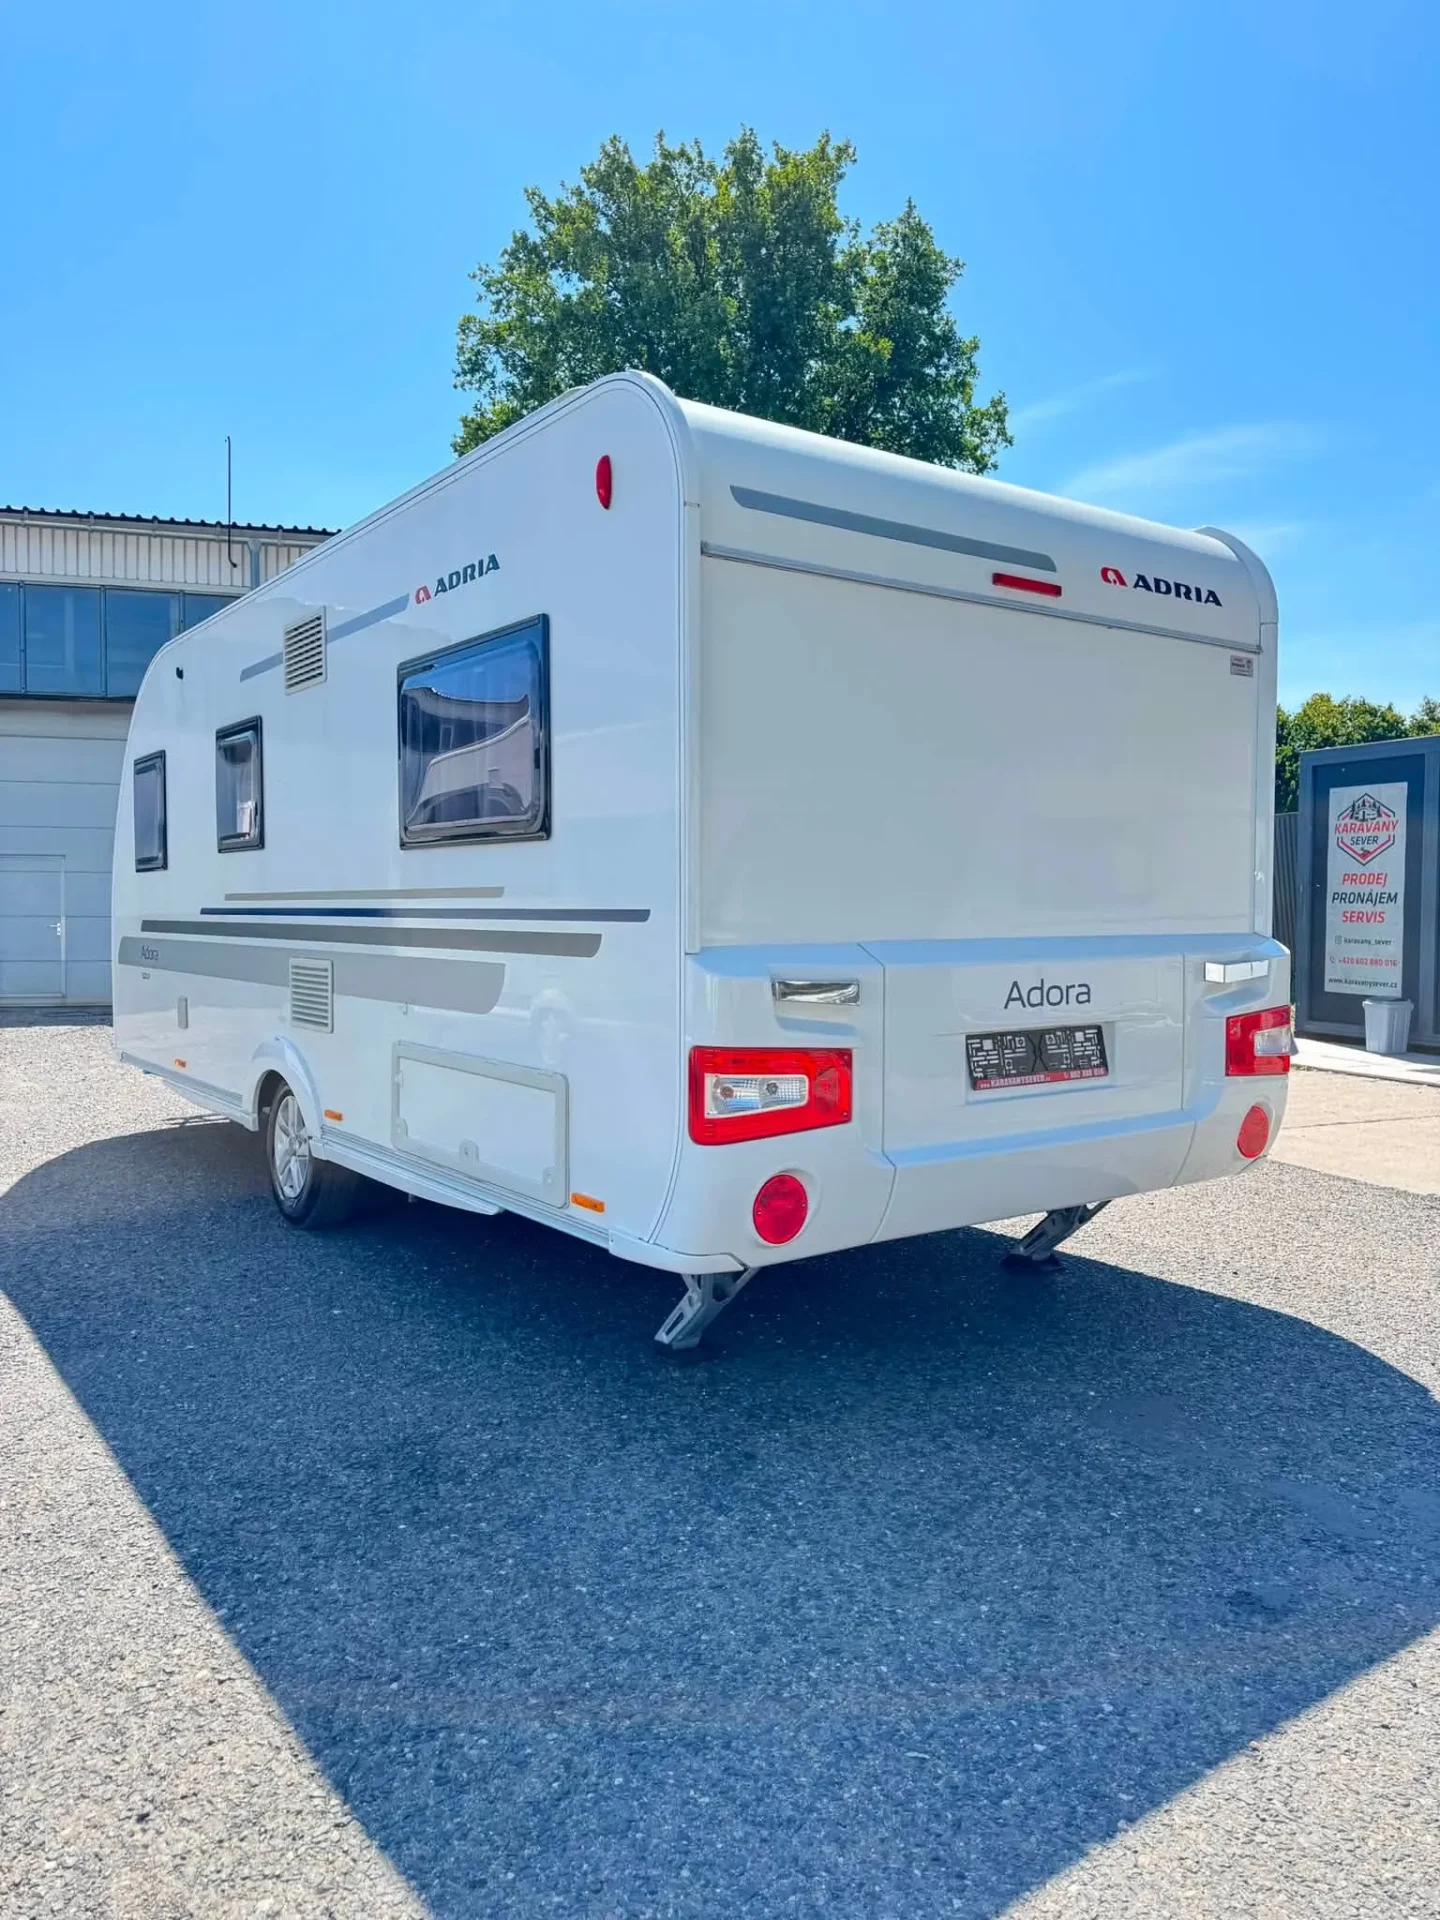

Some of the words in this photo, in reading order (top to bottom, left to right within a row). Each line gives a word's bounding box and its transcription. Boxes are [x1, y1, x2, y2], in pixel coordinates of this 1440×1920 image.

[434, 553, 501, 597] ADRIA
[1132, 573, 1223, 607] ADRIA
[1334, 819, 1399, 834] KARAVANY
[1350, 835, 1379, 846] SEVER
[1341, 872, 1388, 887] PRODEJ
[1331, 888, 1398, 907] PRONÁJEM
[1341, 910, 1385, 924] SERVIS
[1343, 936, 1392, 946] karavany_sever
[1328, 977, 1398, 989] www.karavanysever.cz
[1003, 978, 1091, 1010] Adora
